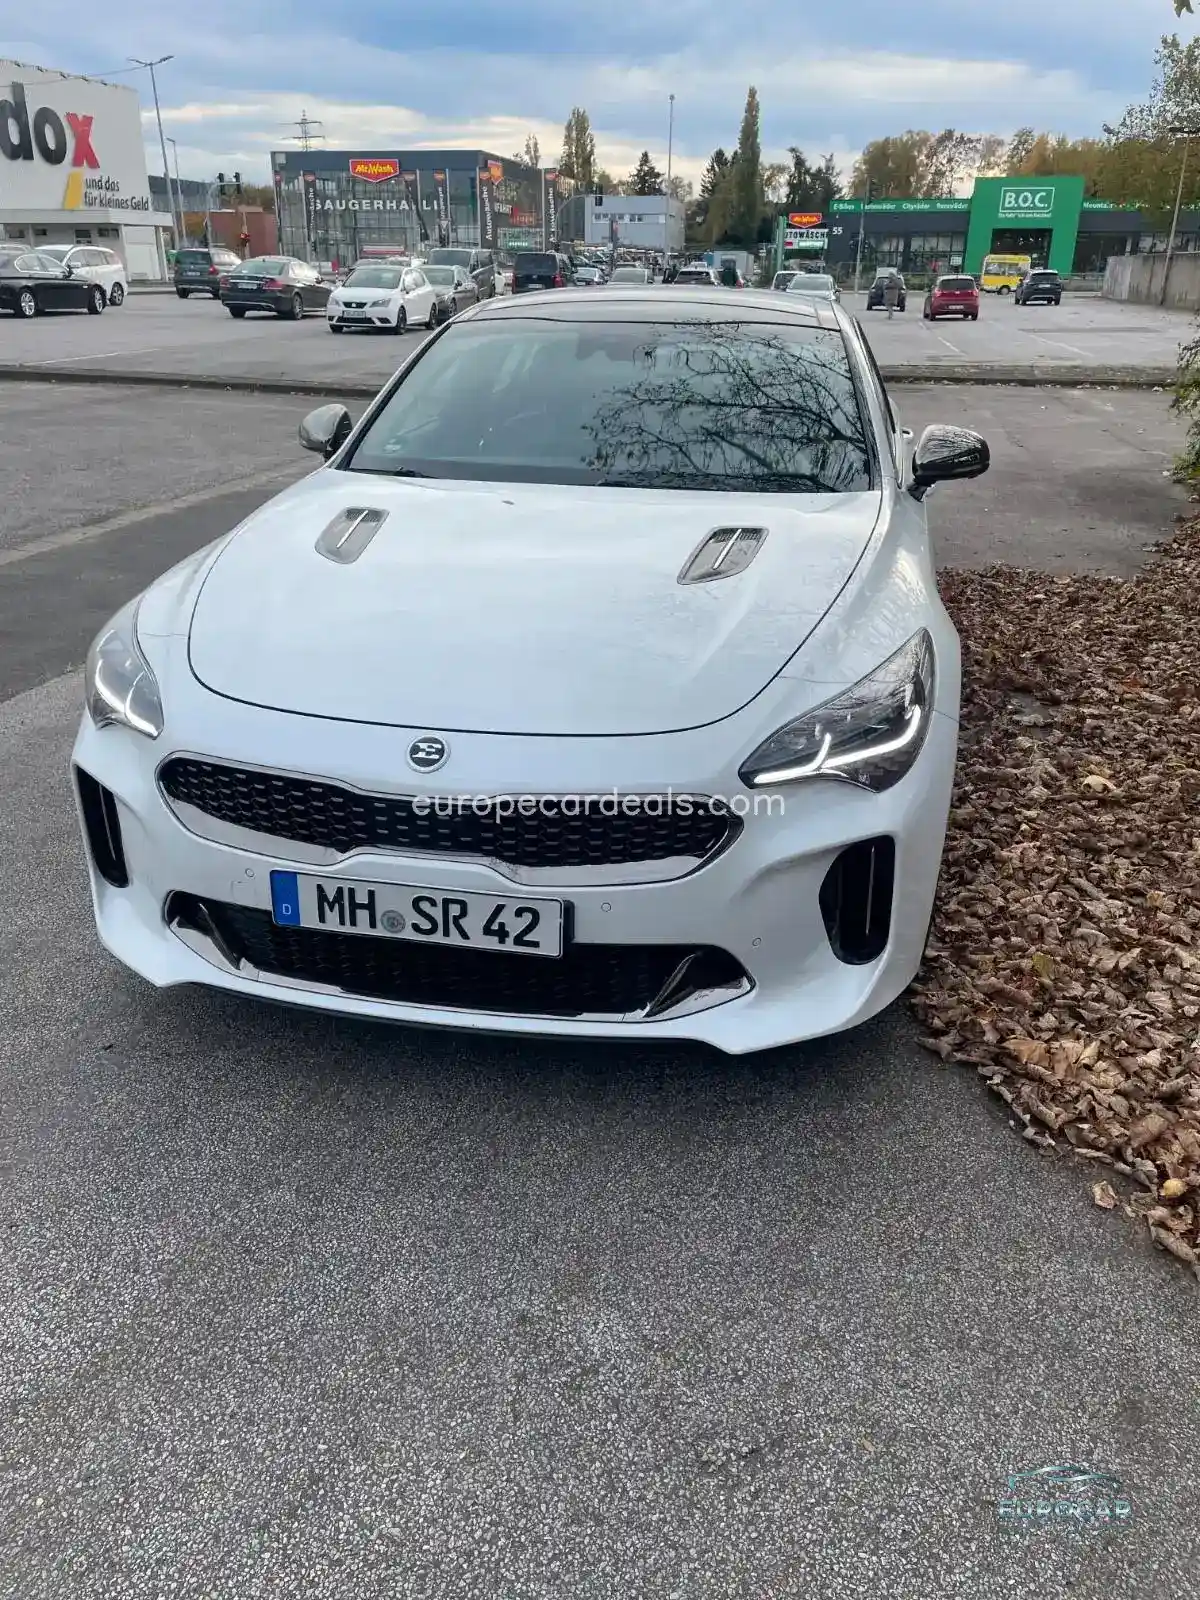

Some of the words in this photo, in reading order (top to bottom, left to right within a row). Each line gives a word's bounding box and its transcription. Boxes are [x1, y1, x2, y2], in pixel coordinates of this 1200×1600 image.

[85, 177, 103, 190] und
[104, 176, 120, 191] das
[84, 191, 97, 207] für
[99, 191, 129, 209] kleines
[130, 196, 149, 210] Geld
[1004, 191, 1048, 208] B.O.C.
[832, 227, 843, 235] 55
[282, 903, 292, 915] D
[316, 883, 377, 929] MH
[411, 895, 470, 940] SR
[483, 904, 541, 948] 42
